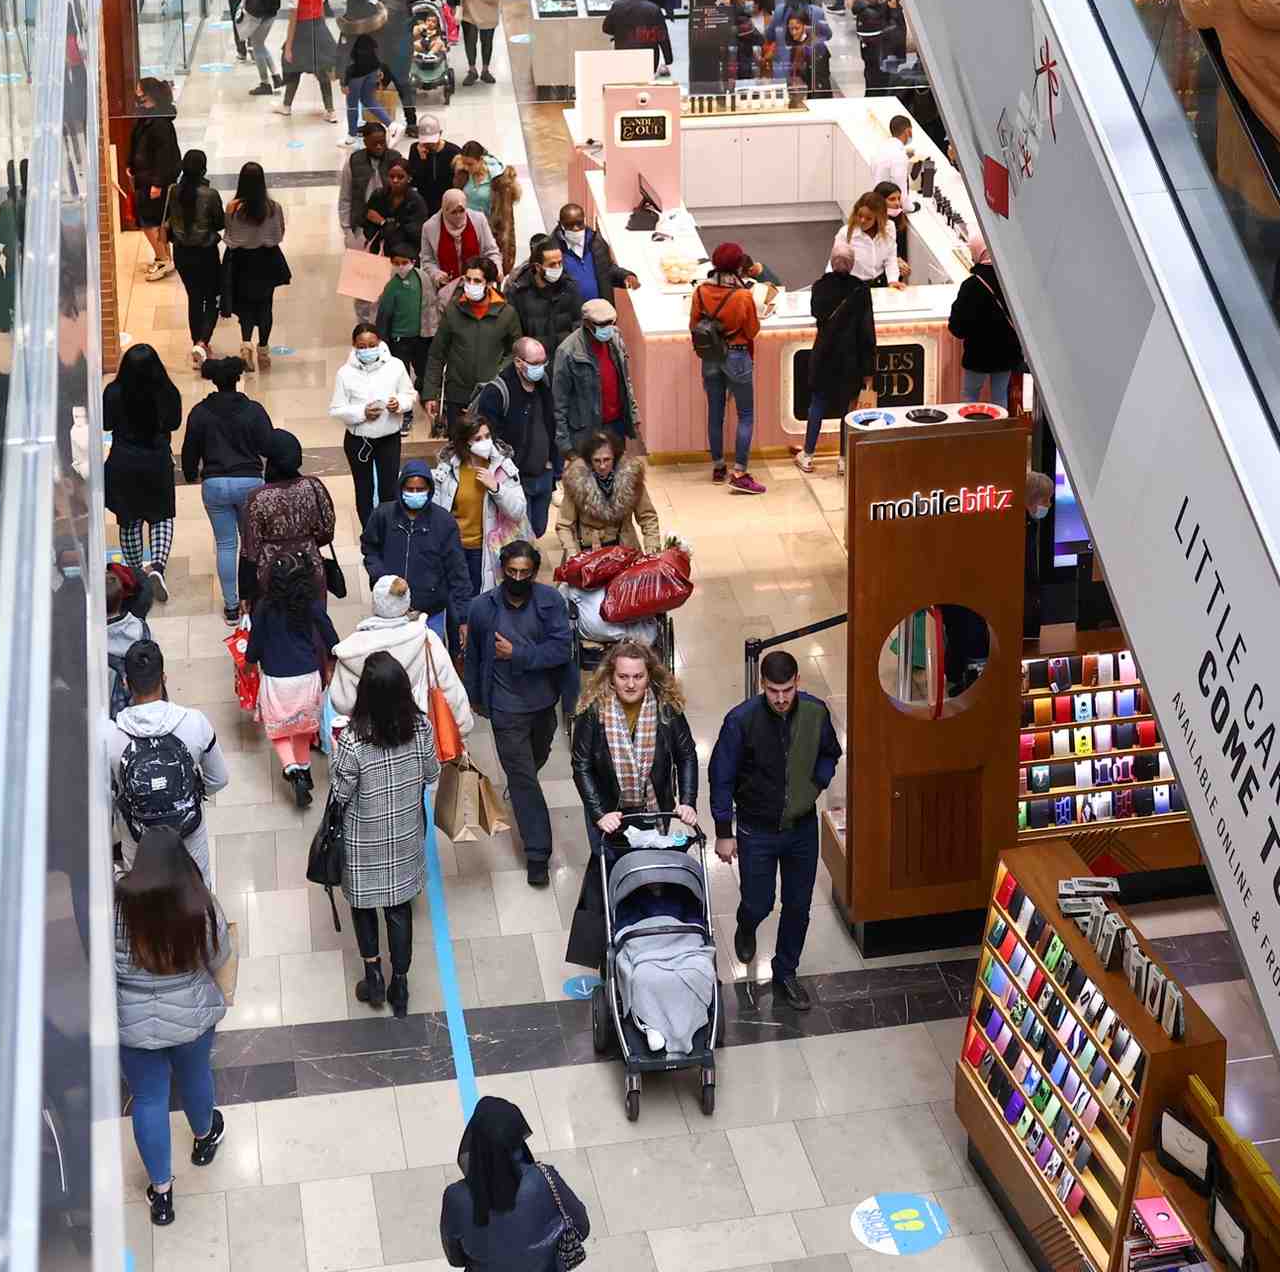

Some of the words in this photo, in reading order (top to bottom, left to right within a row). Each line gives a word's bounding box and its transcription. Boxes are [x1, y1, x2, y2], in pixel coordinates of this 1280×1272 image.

[873, 352, 915, 372] LES
[877, 372, 915, 398] UD
[870, 484, 1015, 521] mobilebitz
[1173, 495, 1248, 683] LITTLE
[1197, 649, 1261, 817] COME
[1170, 691, 1219, 817] AVAILABLE
[1216, 817, 1254, 908] ONLINE
[1250, 910, 1261, 932] &
